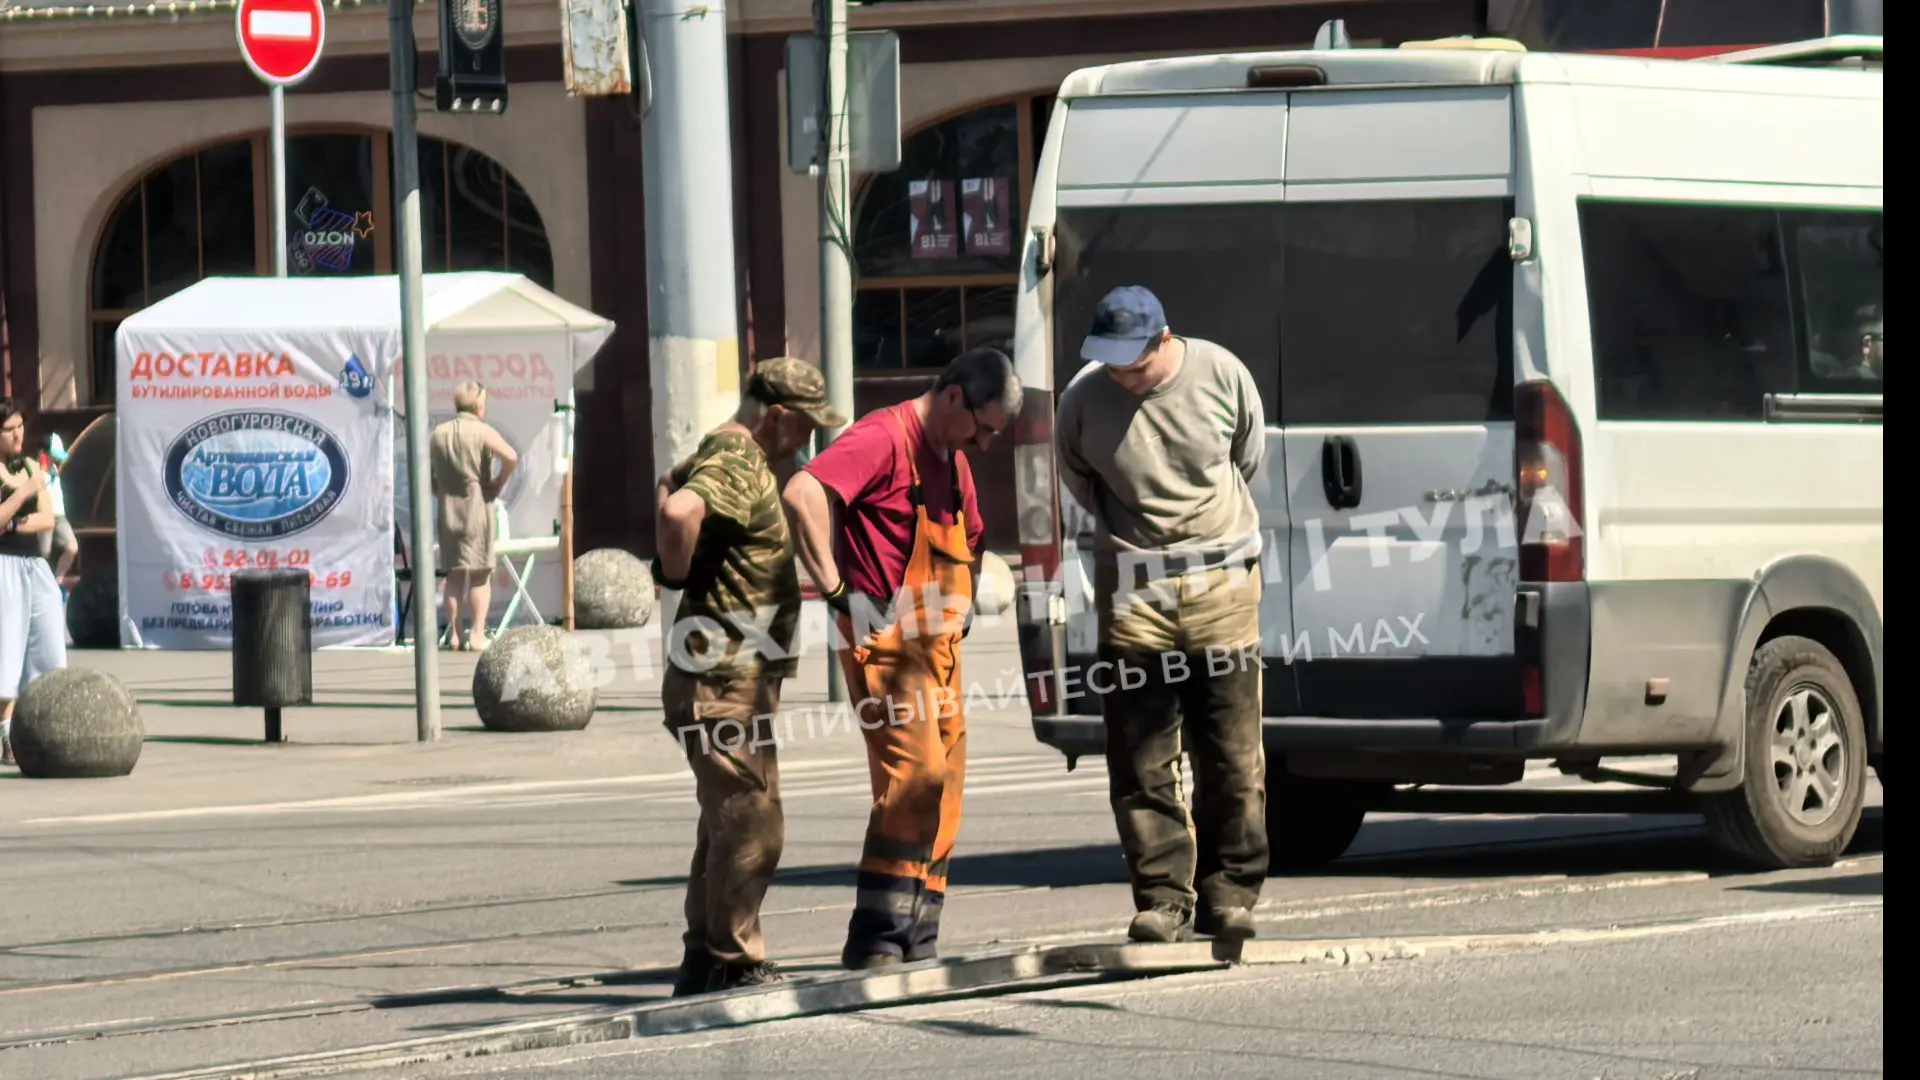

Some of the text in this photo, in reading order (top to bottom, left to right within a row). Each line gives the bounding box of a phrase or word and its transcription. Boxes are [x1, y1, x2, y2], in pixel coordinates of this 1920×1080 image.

[304, 231, 355, 245] OZON
[130, 351, 296, 381] ДОСТАВКА
[131, 382, 332, 399] БУТИЛИРОВАННОЙ ВОДЫ
[185, 413, 327, 449] НОВОГУРОВСКАЯ
[209, 462, 312, 500] ВОДА
